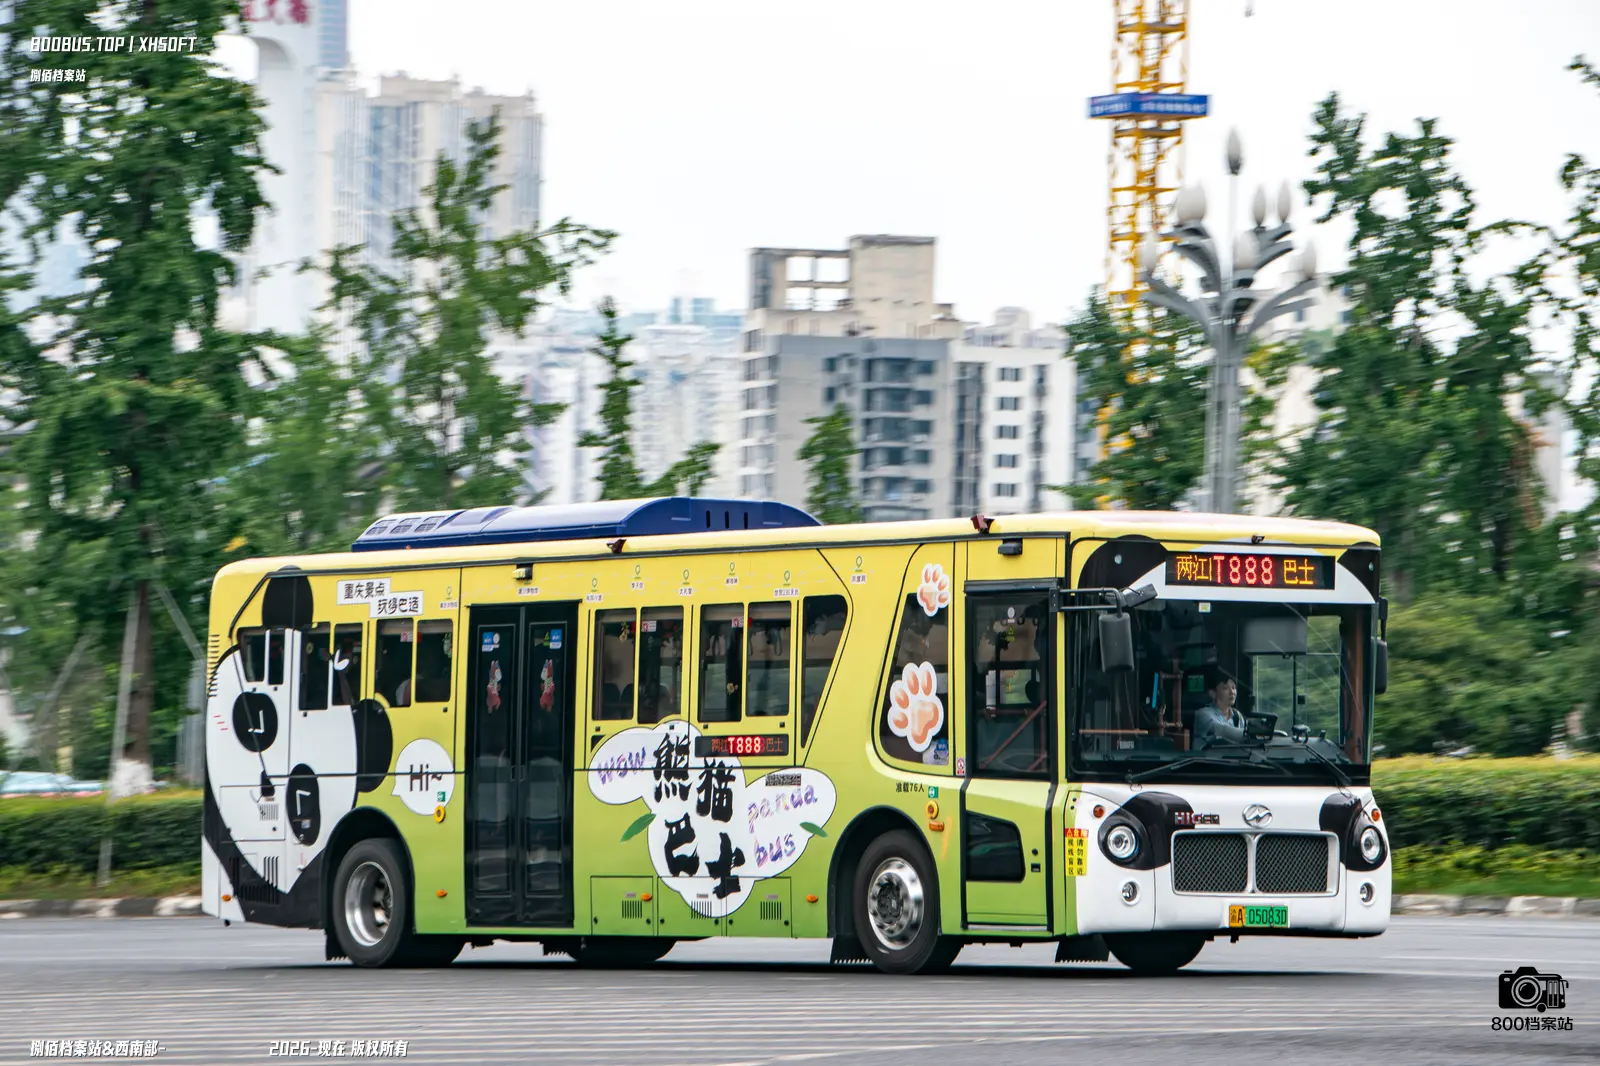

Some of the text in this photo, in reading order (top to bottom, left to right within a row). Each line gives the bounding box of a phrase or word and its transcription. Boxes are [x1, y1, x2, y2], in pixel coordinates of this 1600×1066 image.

[1283, 558, 1315, 585] 巴士
[344, 581, 385, 600] 重庆景点
[748, 785, 818, 834] panda
[754, 833, 796, 868] bus
